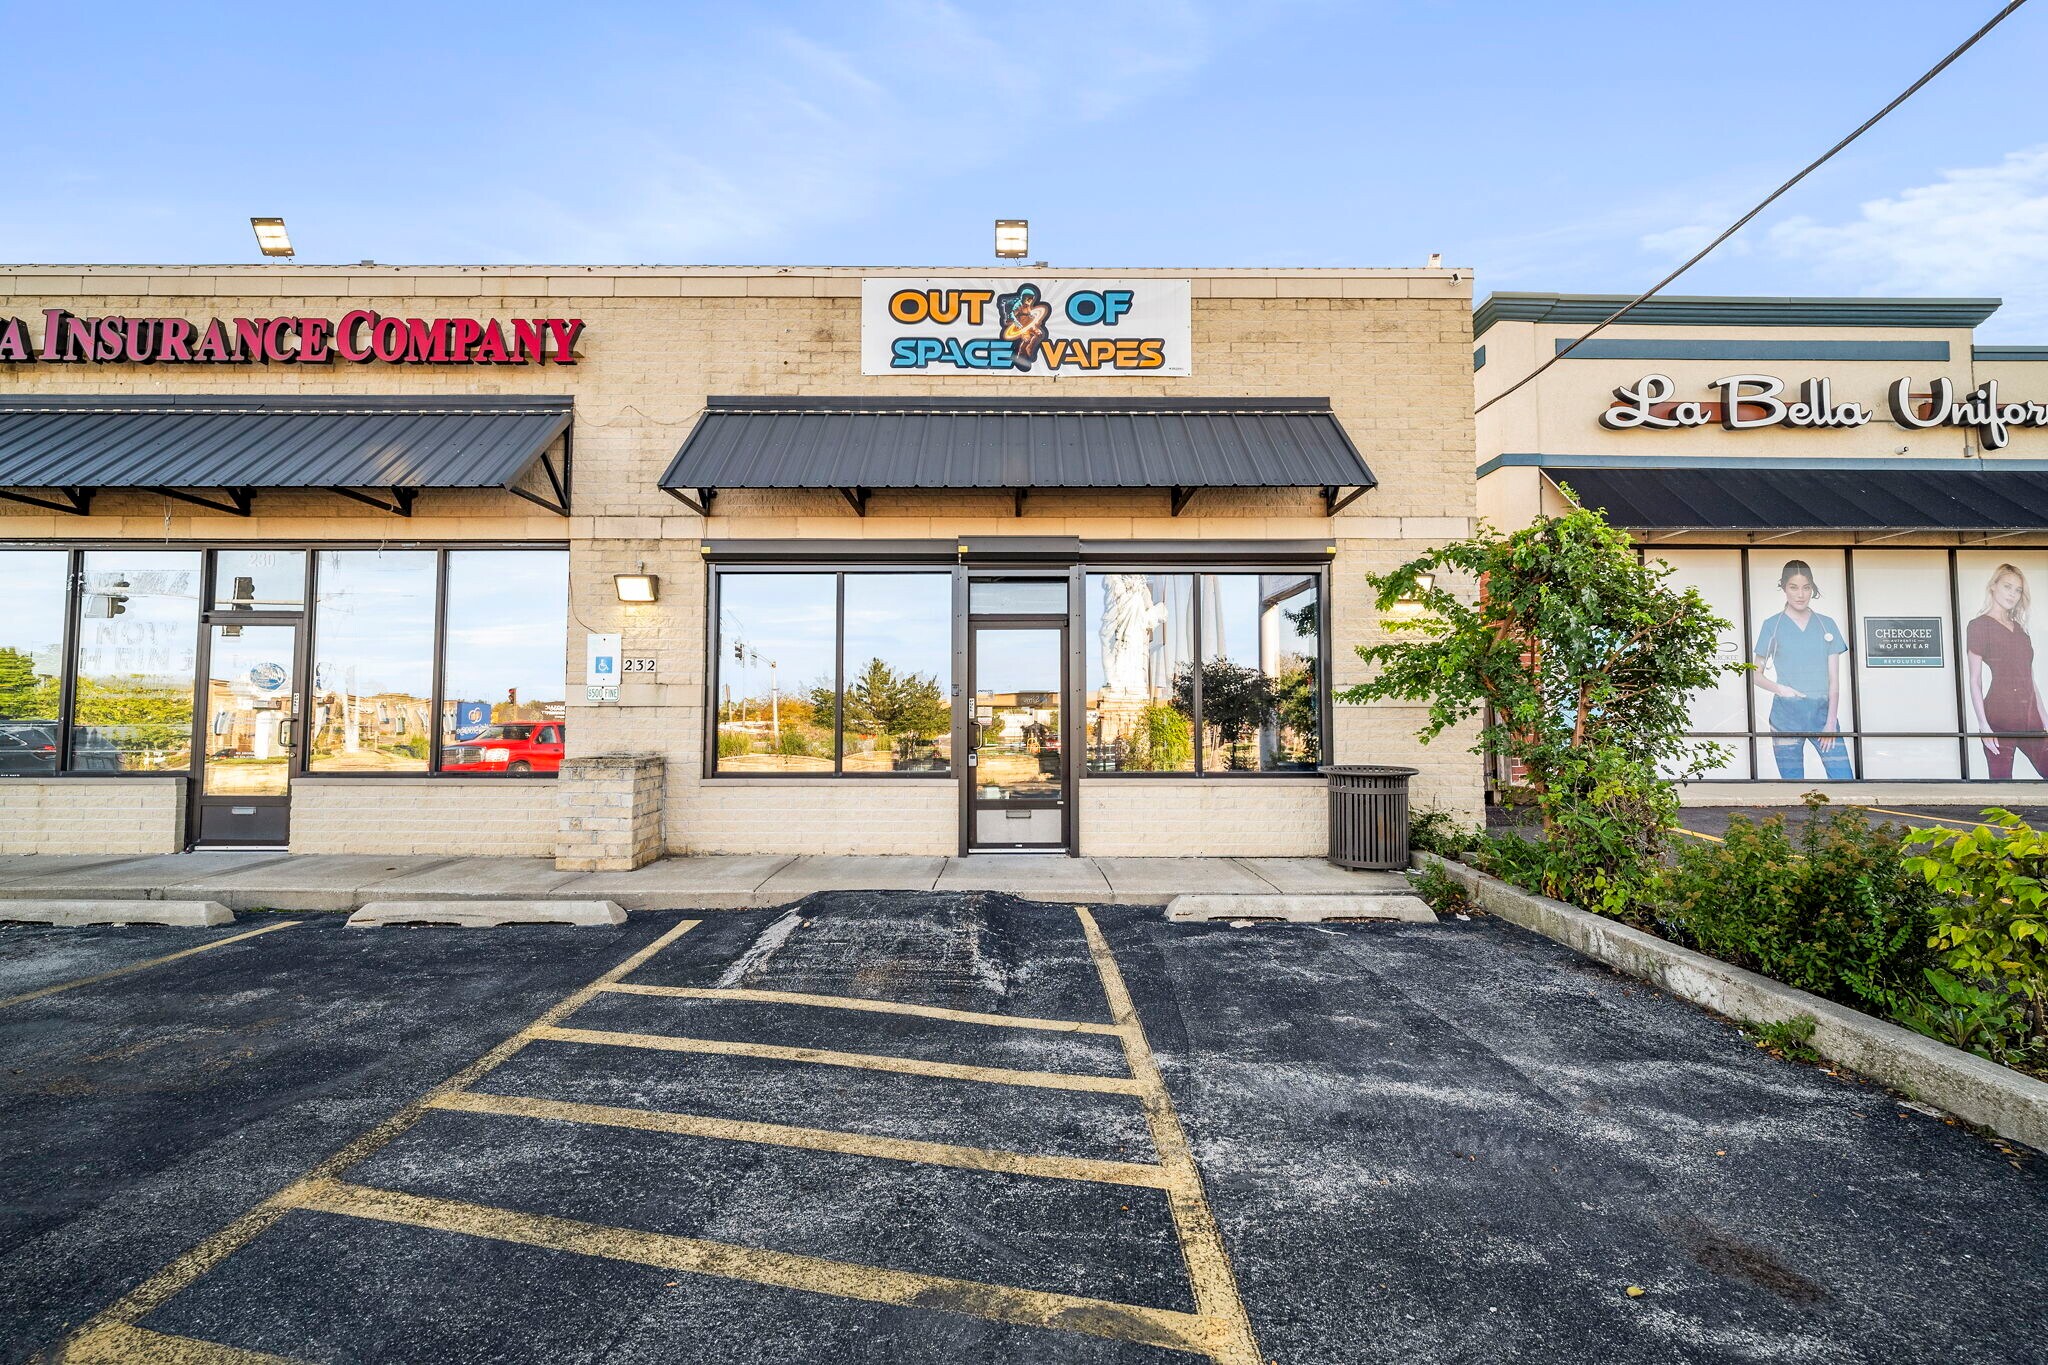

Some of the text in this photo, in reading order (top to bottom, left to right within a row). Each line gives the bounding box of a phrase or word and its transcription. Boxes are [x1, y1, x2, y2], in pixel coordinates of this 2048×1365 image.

[888, 288, 1134, 326] OUT OF
[38, 309, 334, 364] INSURANCE
[336, 309, 586, 365] COMPANY
[889, 336, 1166, 370] SPACE VAPES
[1599, 373, 2048, 450] La Bella Unifor
[1875, 628, 1932, 638] CHEROKEE
[624, 659, 655, 671] 232
[588, 688, 618, 698] $500 FINE
